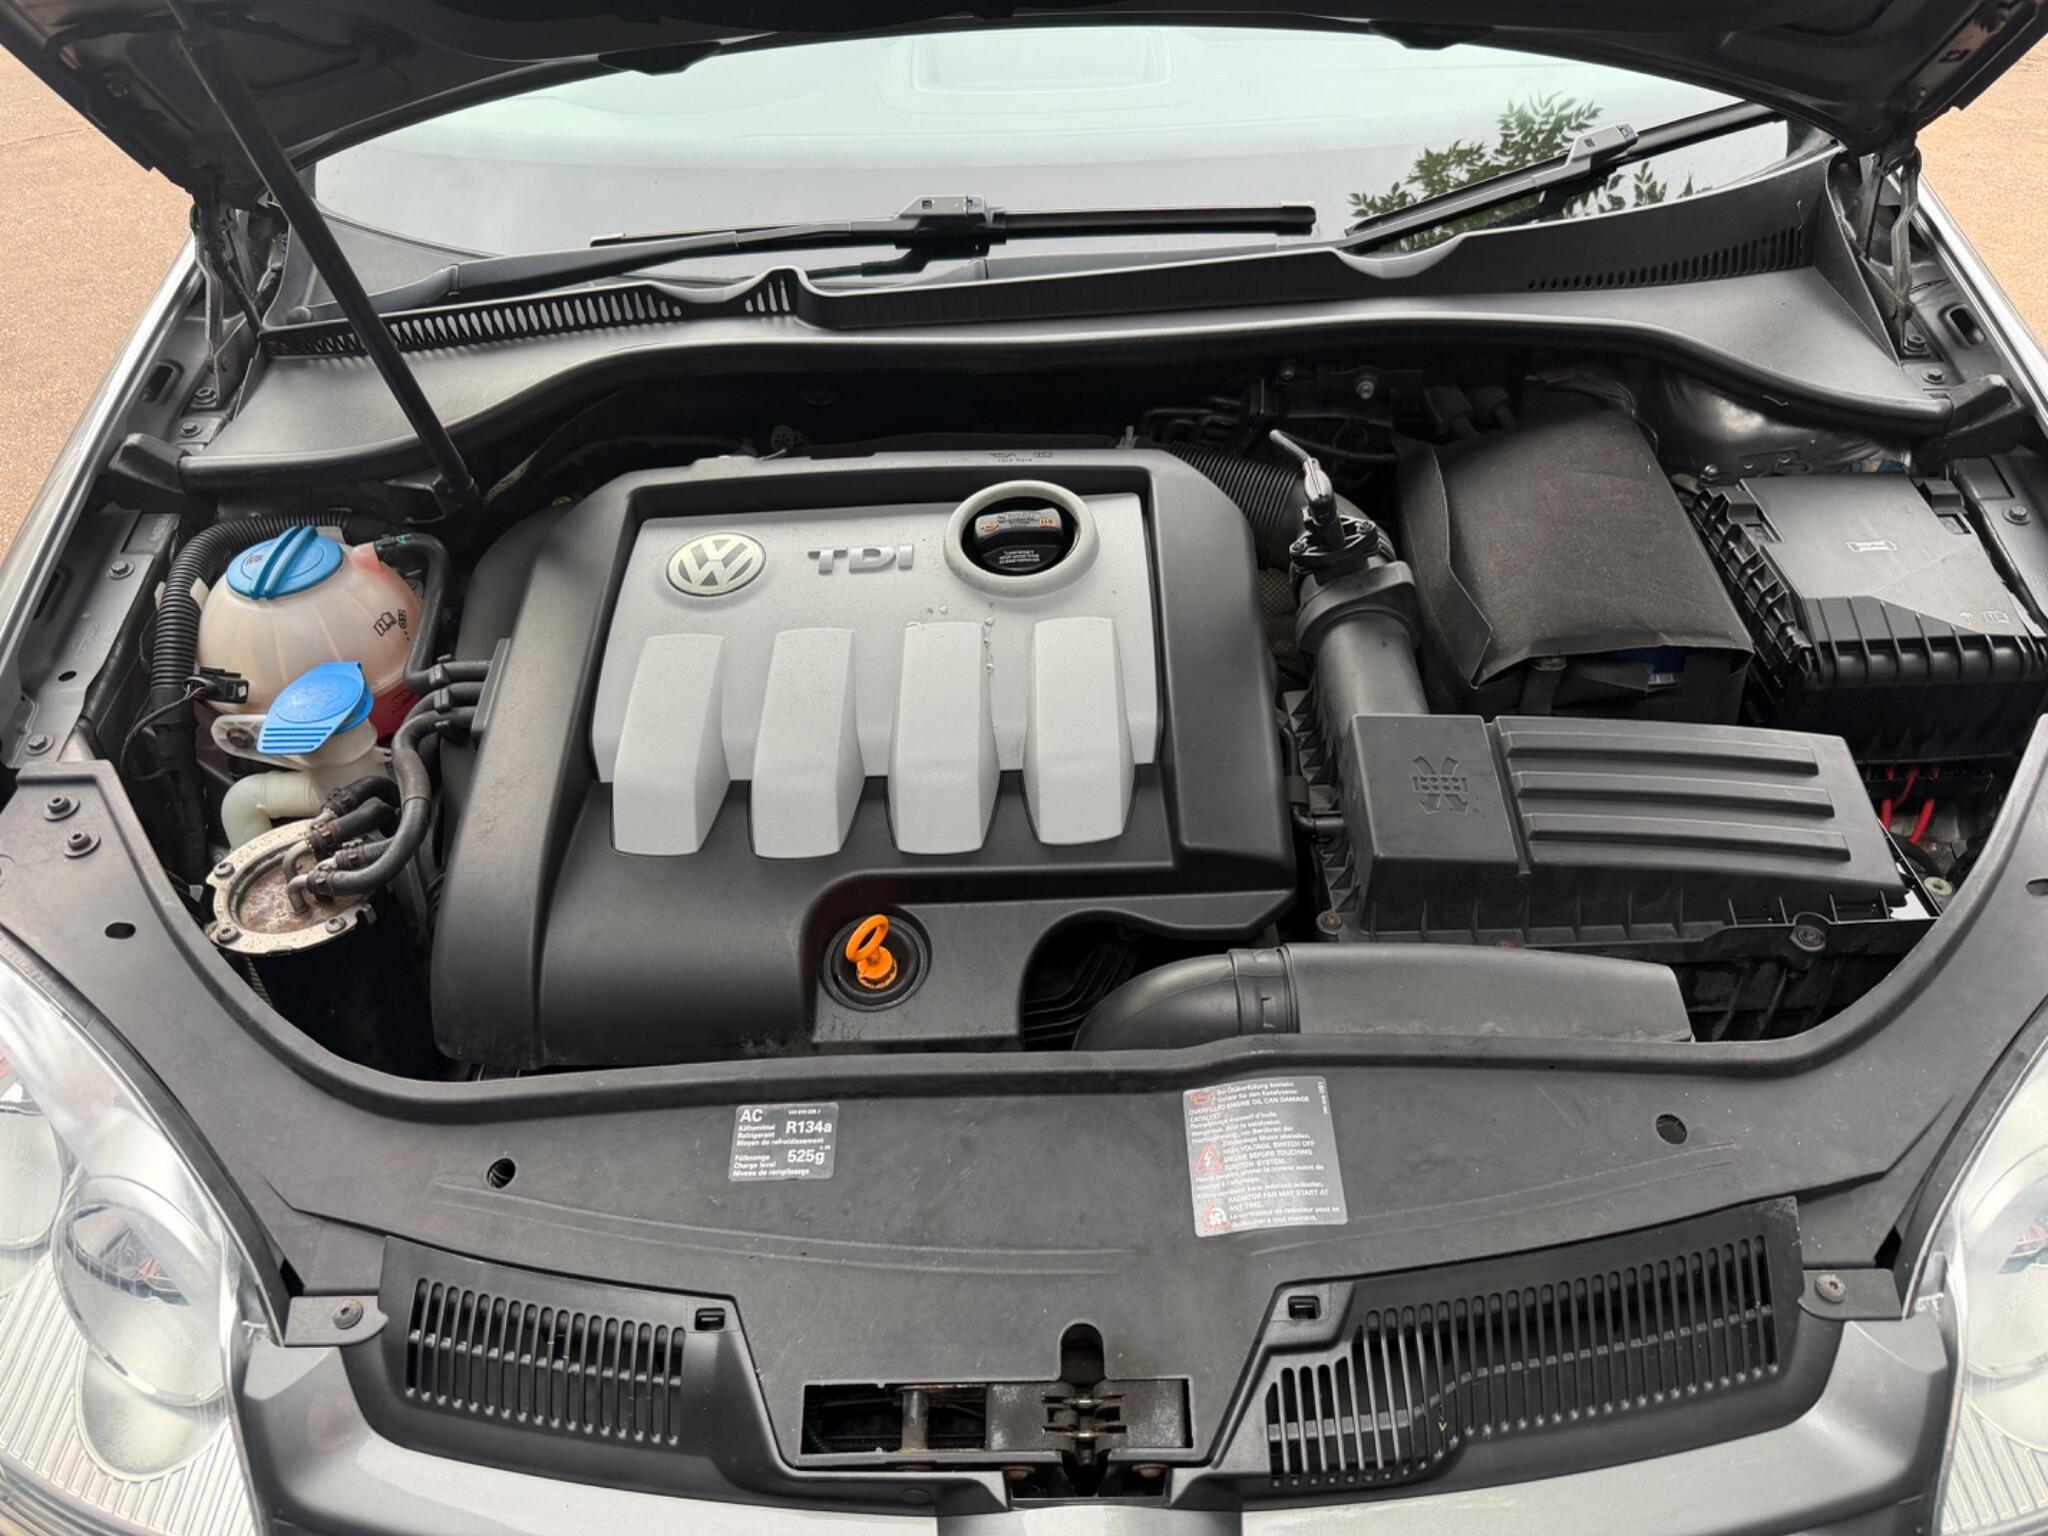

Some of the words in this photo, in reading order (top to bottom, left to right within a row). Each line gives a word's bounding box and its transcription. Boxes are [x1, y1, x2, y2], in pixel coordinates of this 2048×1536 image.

[808, 542, 915, 576] TDI
[740, 1108, 763, 1122] AC
[785, 1120, 833, 1134] R134a
[787, 1149, 825, 1165] 525g
[758, 1169, 768, 1177] de
